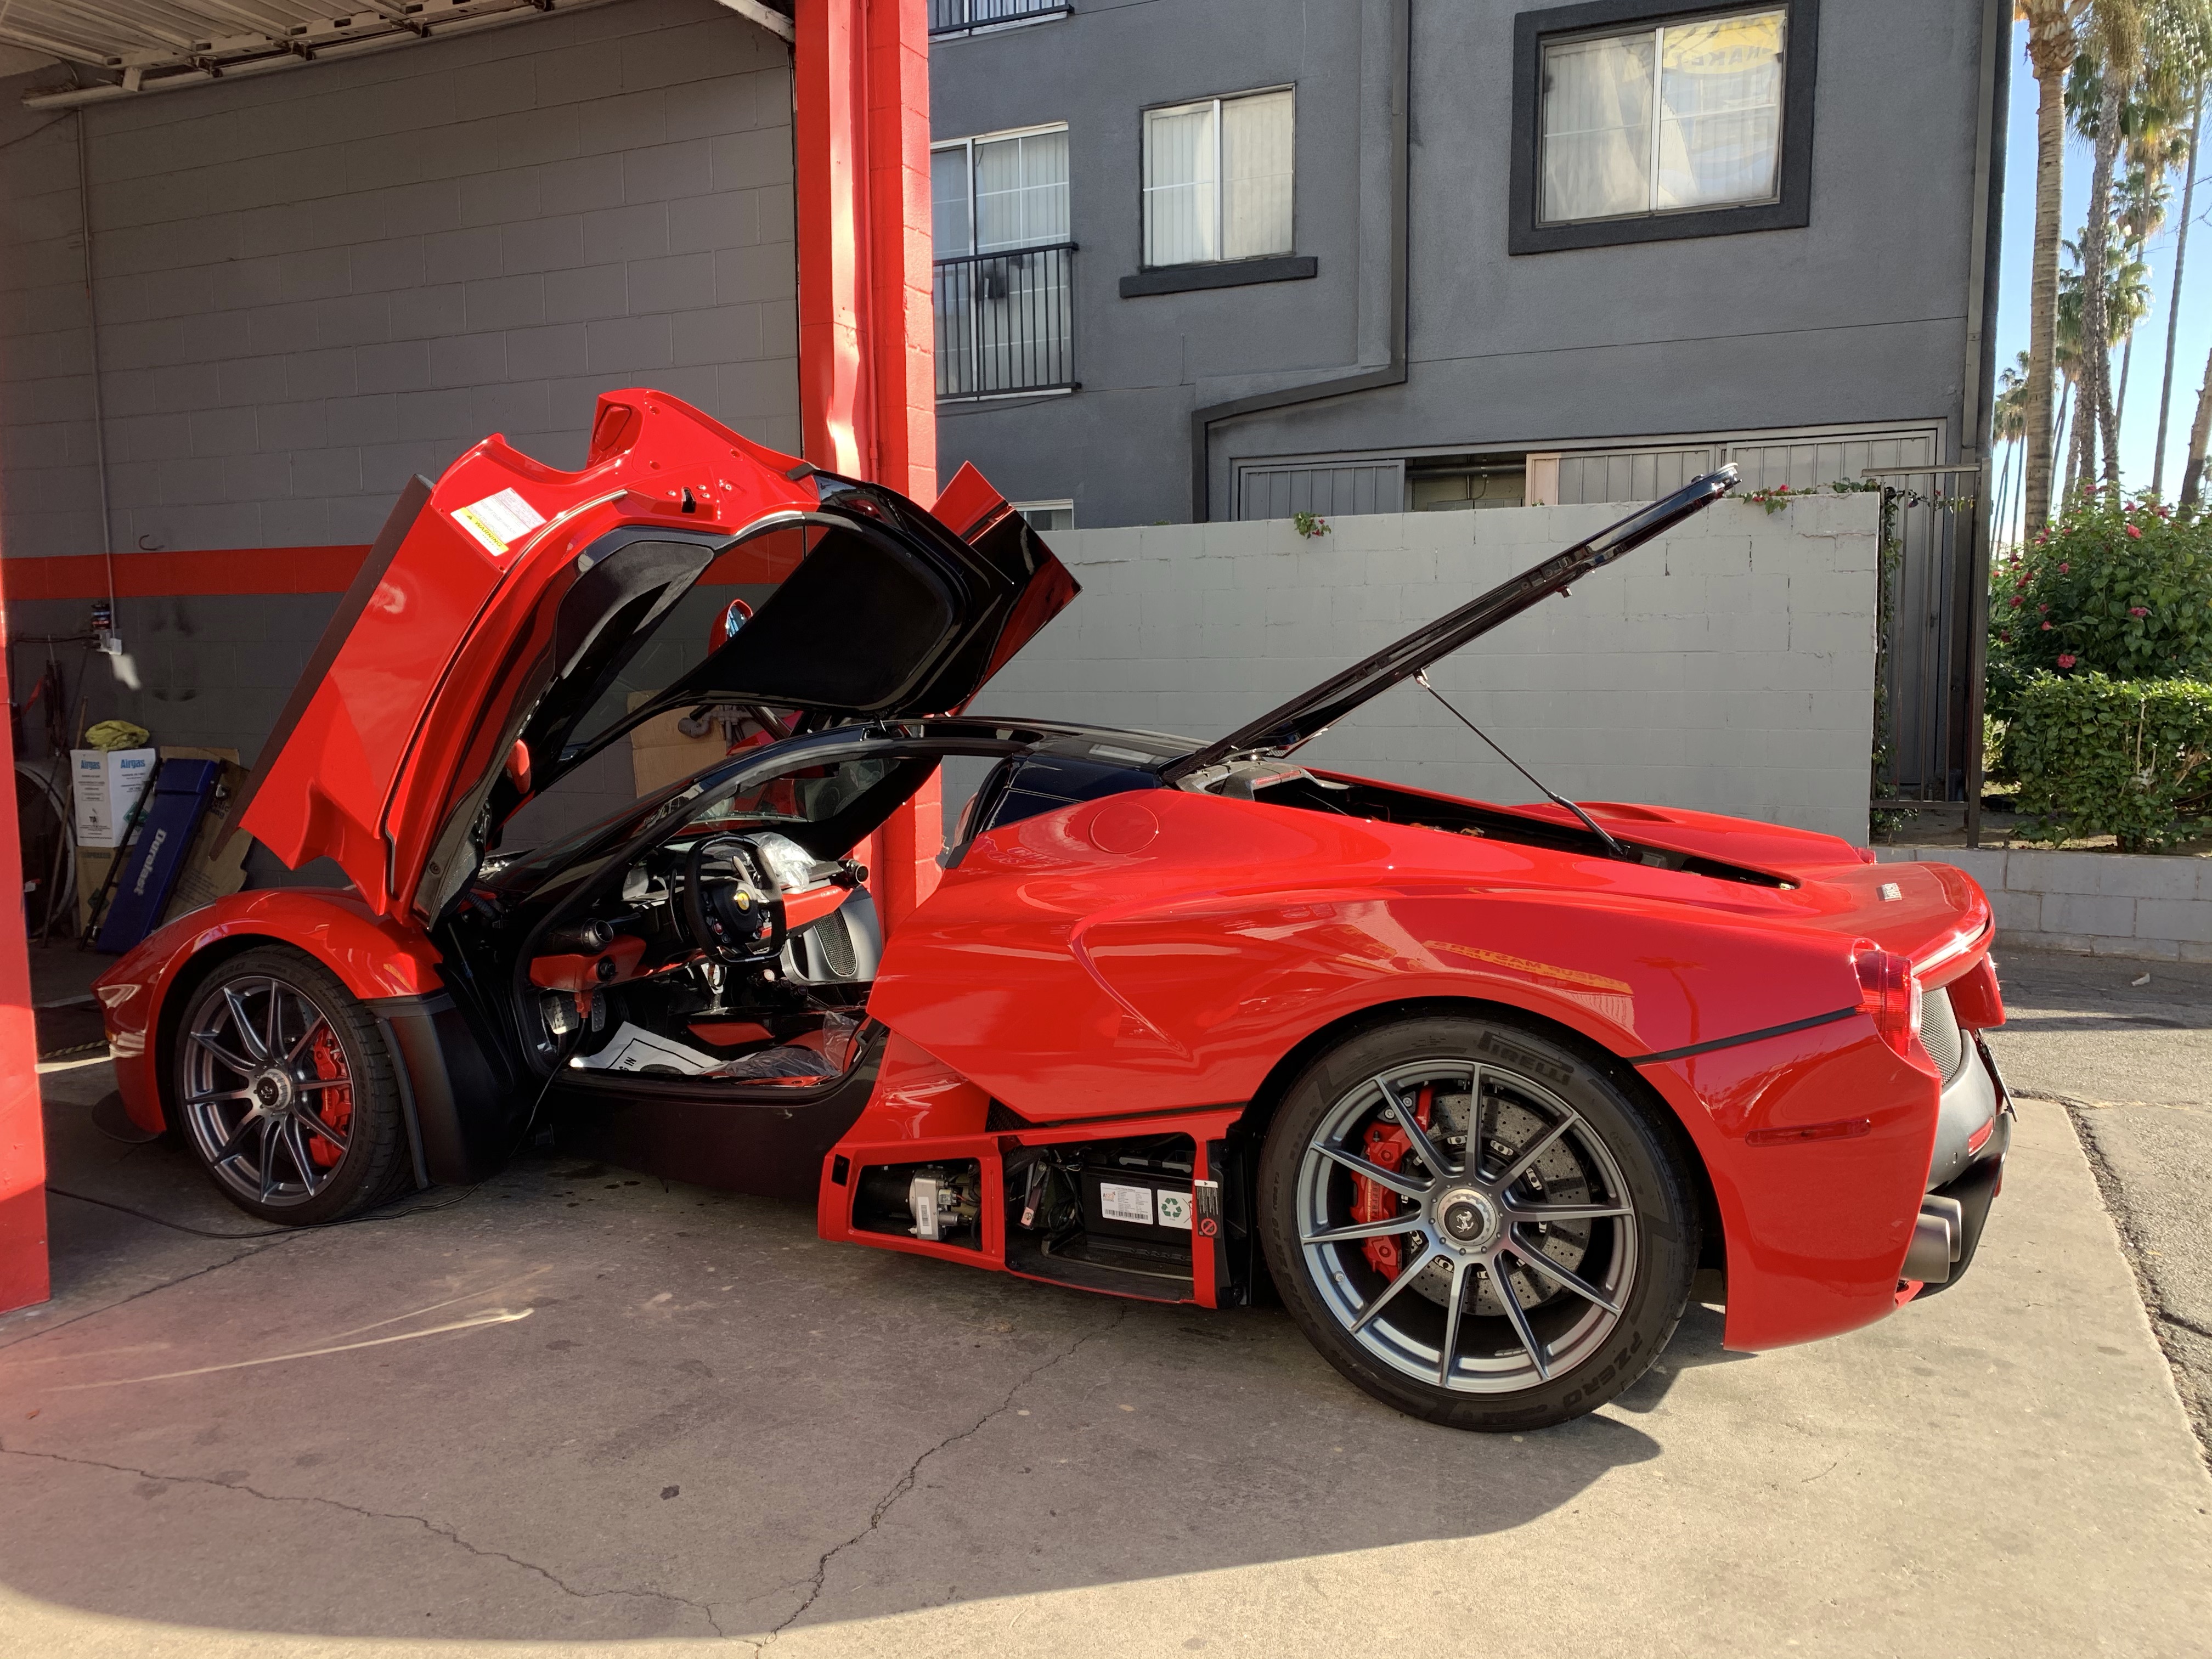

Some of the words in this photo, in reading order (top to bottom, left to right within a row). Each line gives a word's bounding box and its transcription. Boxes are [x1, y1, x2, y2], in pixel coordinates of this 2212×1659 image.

[475, 521, 503, 547] WARNING
[81, 759, 101, 770] Airgas
[120, 759, 145, 769] Airgas
[133, 828, 167, 896] Duralast
[624, 1057, 636, 1066] IN
[1477, 1030, 1574, 1086] PIRELLI
